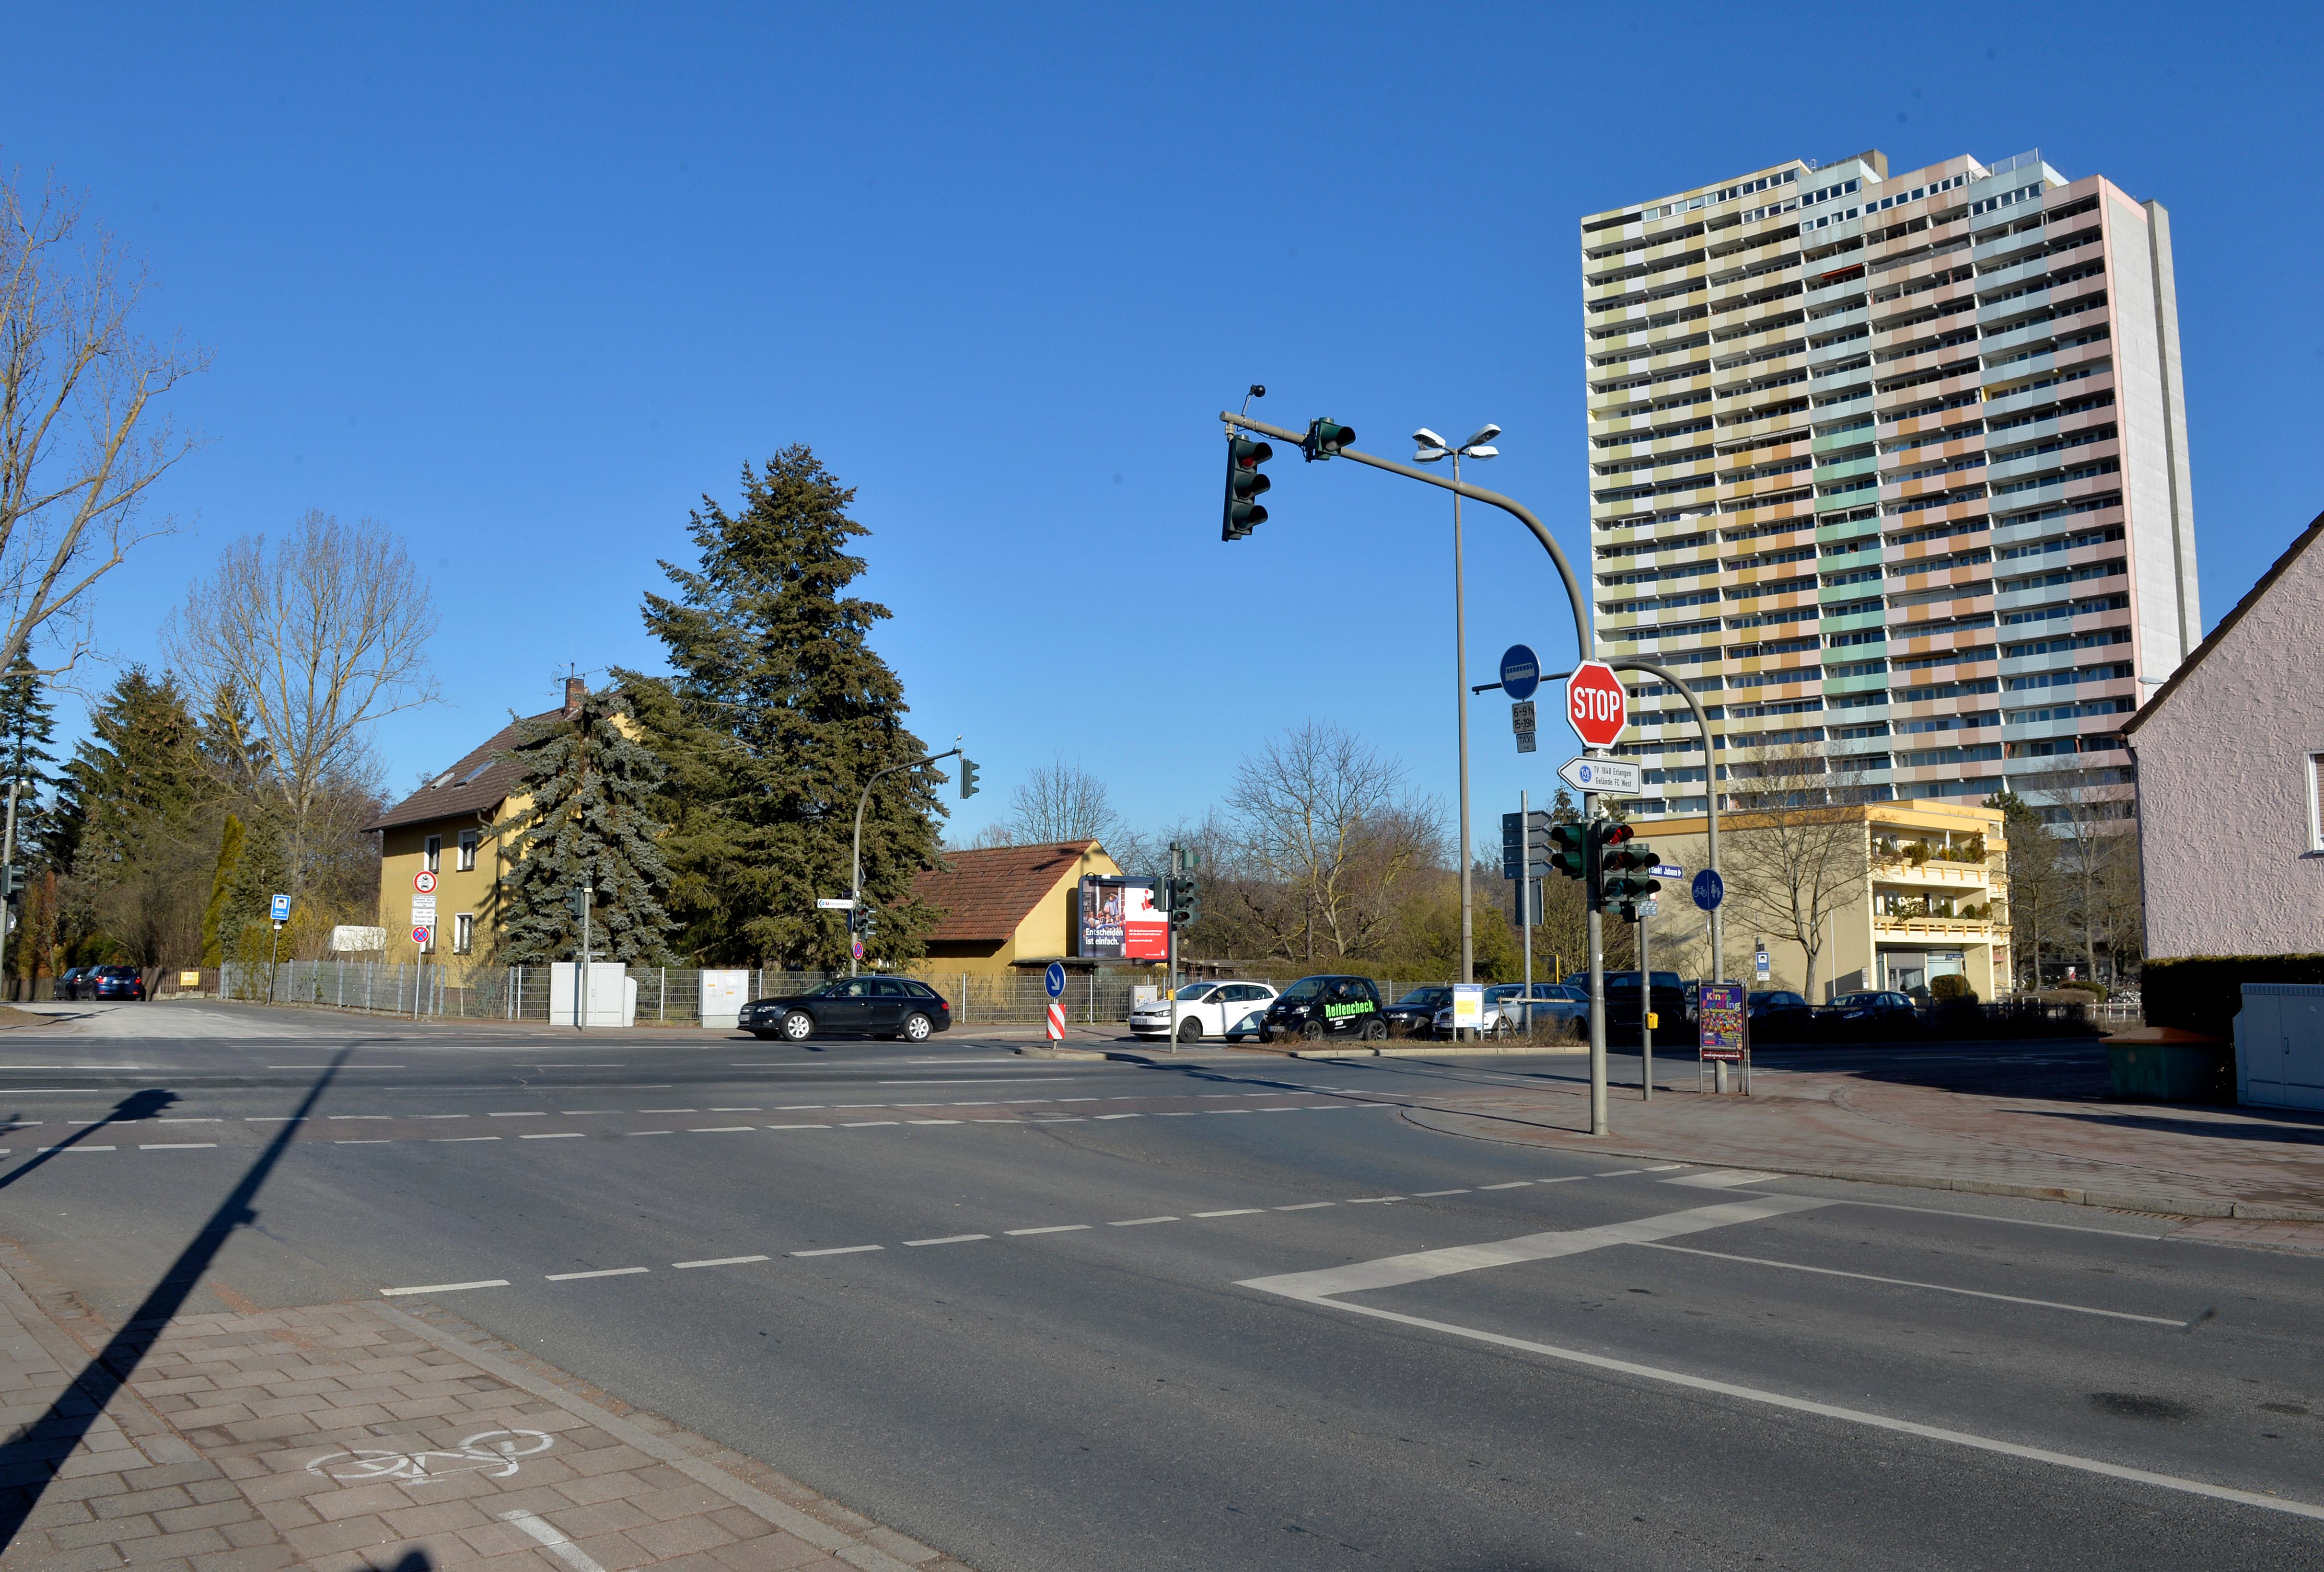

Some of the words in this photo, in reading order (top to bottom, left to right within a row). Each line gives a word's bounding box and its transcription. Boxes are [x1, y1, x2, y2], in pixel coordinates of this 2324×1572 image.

[1574, 686, 1620, 722] STOP
[1514, 706, 1527, 717] 6-9
[1514, 718, 1534, 729] 15-19h
[1519, 736, 1533, 744] TAXI
[1601, 767, 1611, 775] 1848
[1613, 769, 1631, 778] Erlangen
[1595, 777, 1613, 786] Gelände
[1651, 866, 1662, 874] Sankt
[1085, 928, 1123, 936] Entscheiden
[1085, 937, 1094, 945] ist
[1095, 937, 1119, 945] einfach.
[1325, 999, 1373, 1017] Reifencheck
[1702, 1000, 1741, 1012] Fasching
